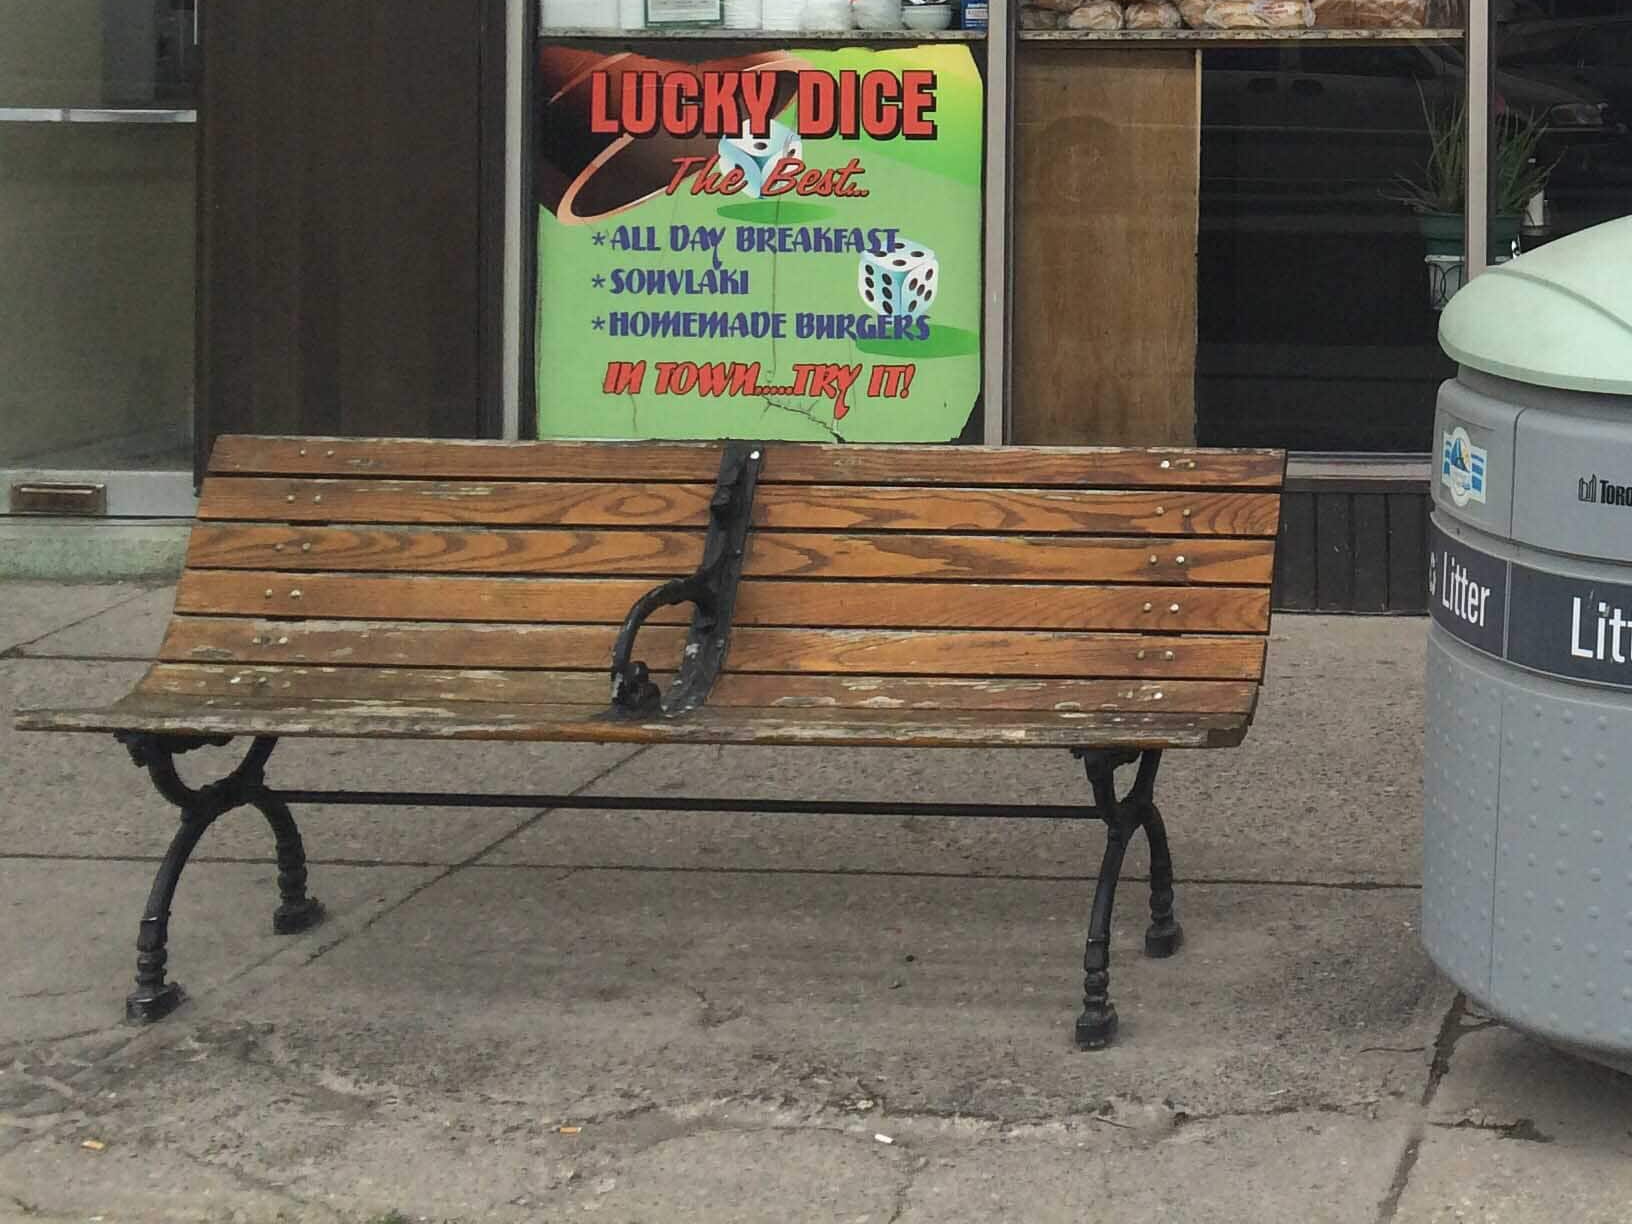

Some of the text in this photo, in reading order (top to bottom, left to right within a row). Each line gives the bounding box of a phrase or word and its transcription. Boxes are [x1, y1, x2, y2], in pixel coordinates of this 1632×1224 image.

[590, 69, 939, 139] LUCKY DICE
[665, 152, 749, 197] The
[610, 225, 900, 269] ALL DAY BREAKFAST
[609, 268, 749, 296] SOUVLAKI
[609, 311, 931, 341] HOMEMADE BURGERS
[602, 360, 647, 395] IN
[867, 364, 917, 399] IT!
[1441, 551, 1492, 628] Litter
